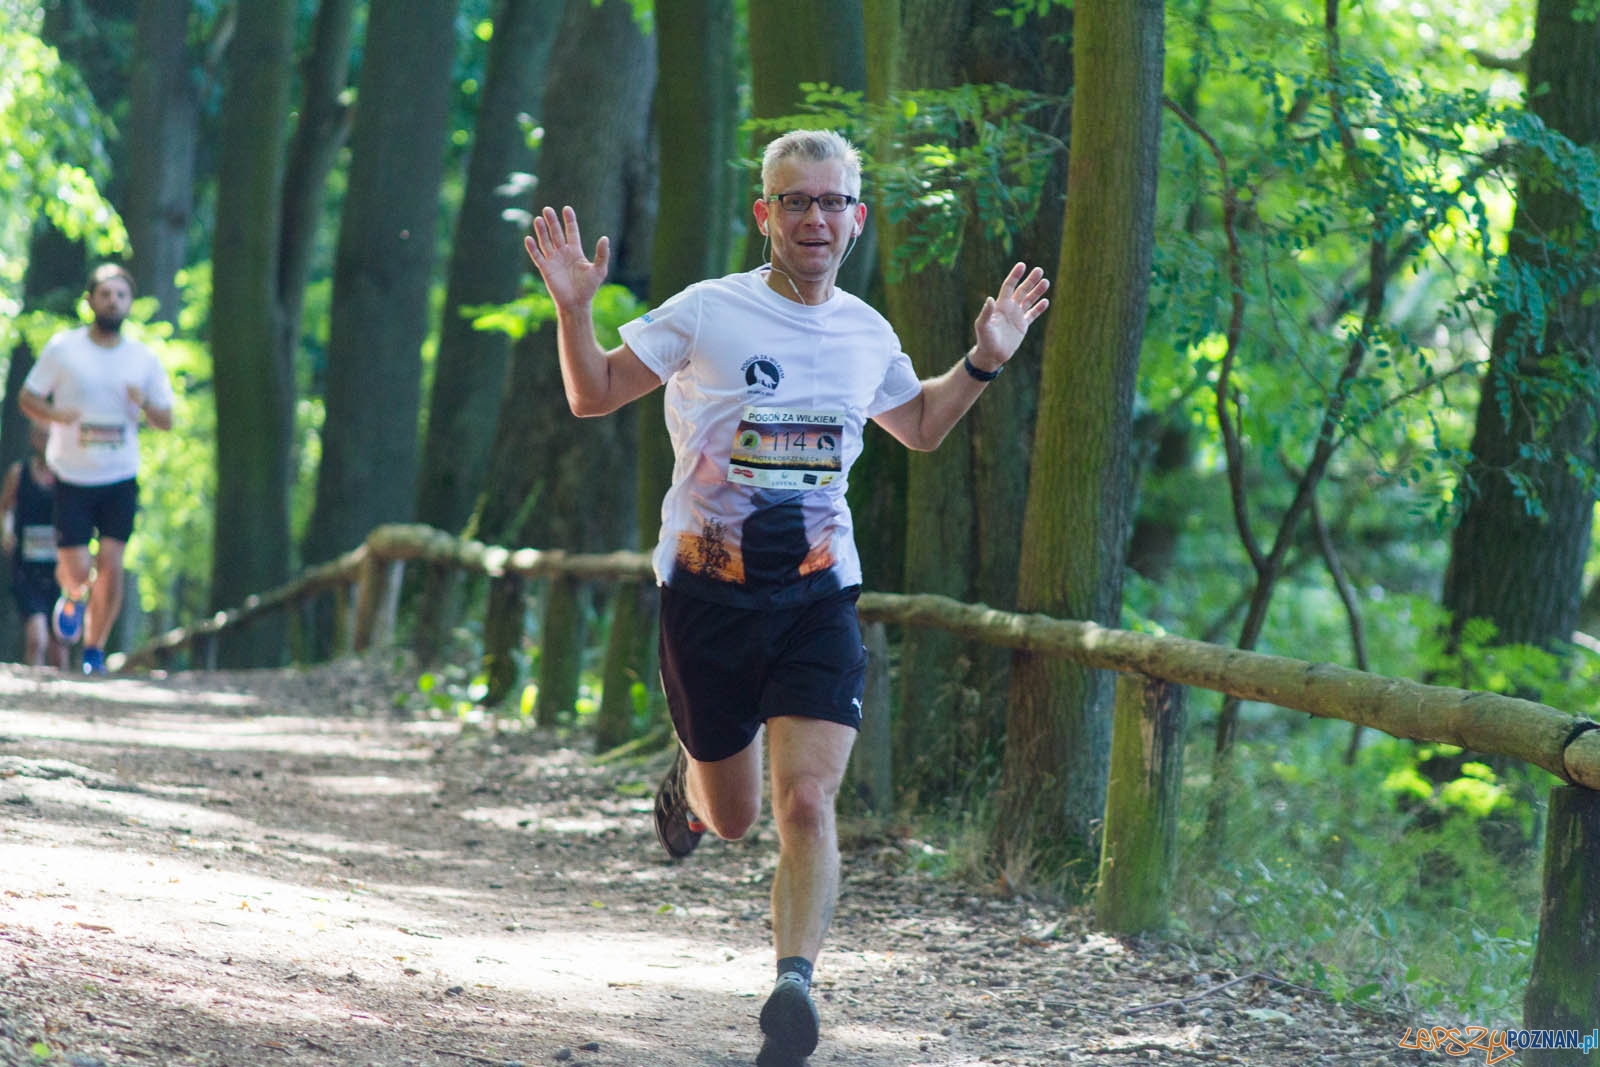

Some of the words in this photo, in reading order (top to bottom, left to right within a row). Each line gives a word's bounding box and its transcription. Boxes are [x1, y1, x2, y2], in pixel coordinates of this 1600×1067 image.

[783, 413, 794, 422] ZA
[797, 414, 837, 424] WILKIEM
[770, 431, 807, 451] 114
